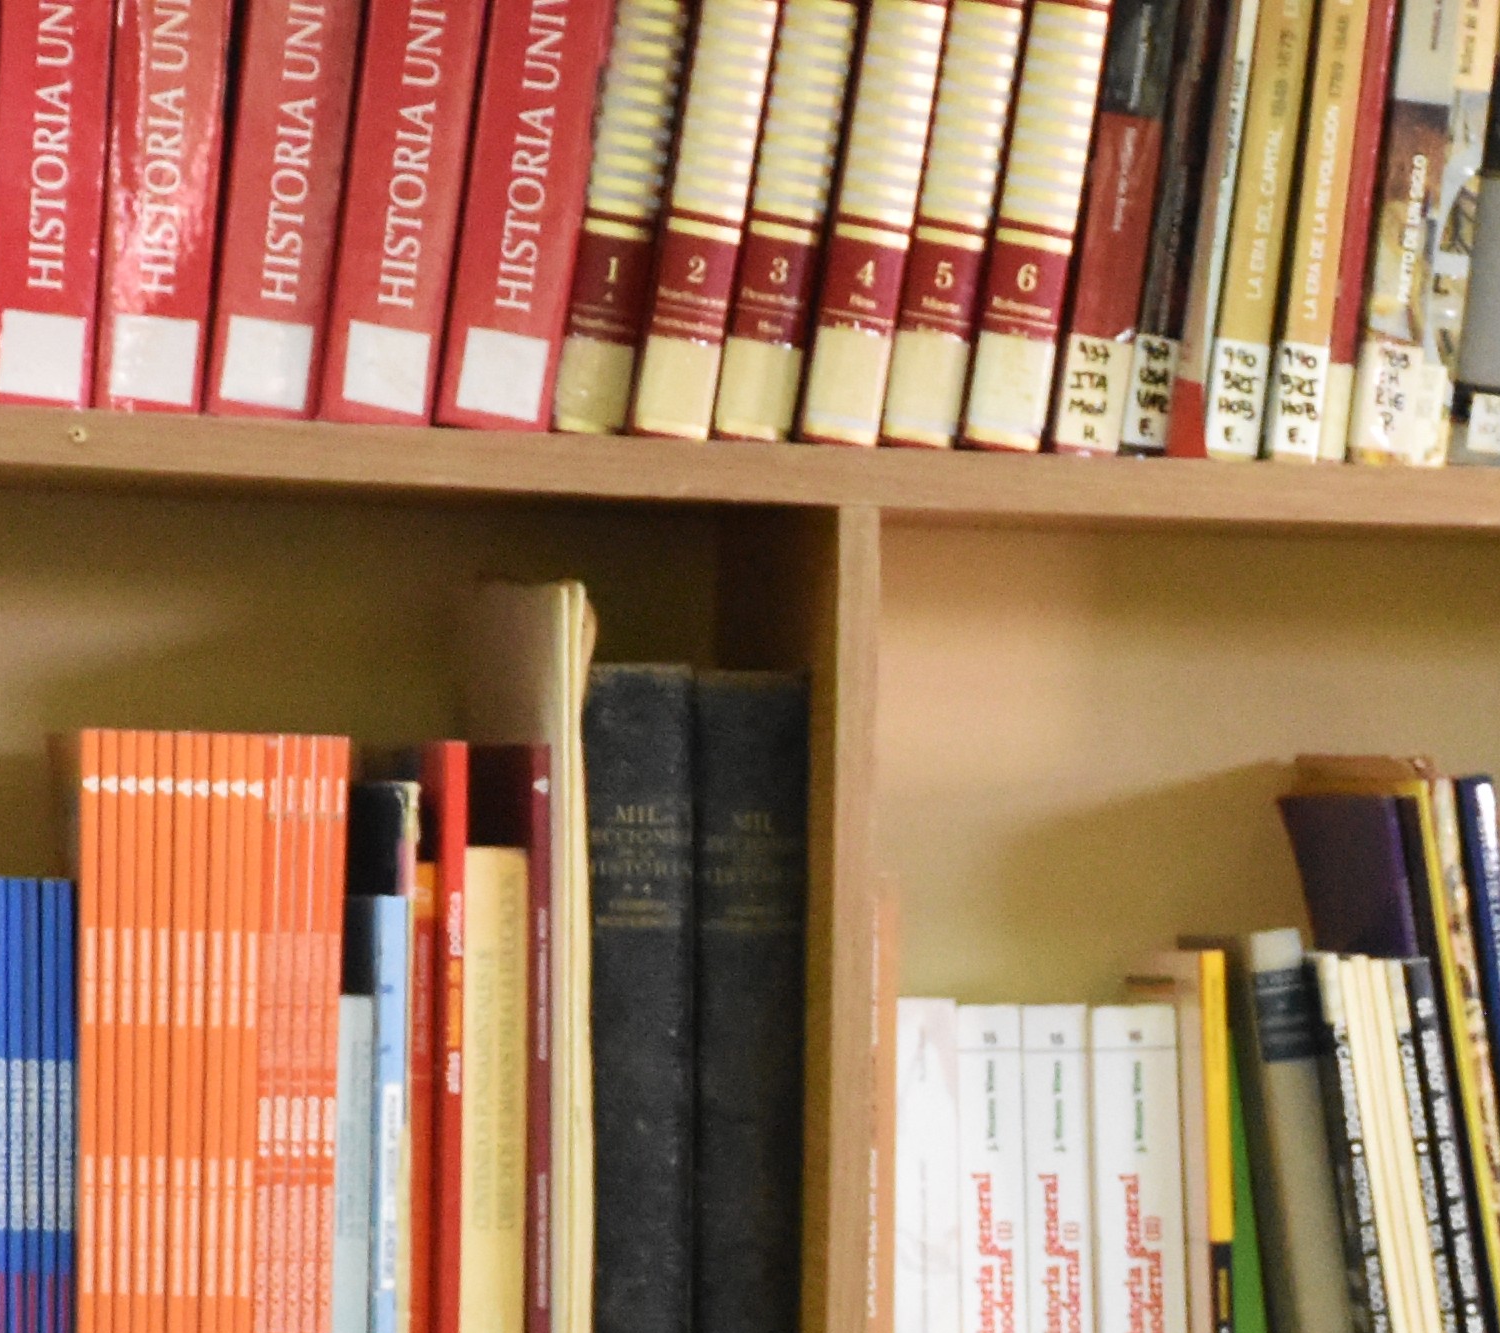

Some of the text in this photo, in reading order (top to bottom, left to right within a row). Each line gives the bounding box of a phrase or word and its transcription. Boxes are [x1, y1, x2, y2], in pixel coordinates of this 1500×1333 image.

[20, 78, 82, 290] HISTORIA
[134, 85, 192, 294] HISTORIA
[256, 93, 319, 302] HISTORIA
[372, 97, 440, 308] HISTORIA
[489, 101, 560, 312] HISTORIA
[607, 258, 619, 283] 1
[687, 258, 706, 284] 2
[770, 259, 789, 284] 3
[856, 261, 876, 288] 4
[935, 263, 954, 290] 5
[1017, 265, 1037, 292] 6
[971, 1172, 994, 1255] general
[1039, 1173, 1061, 1256] general
[1119, 1174, 1146, 1257] general
